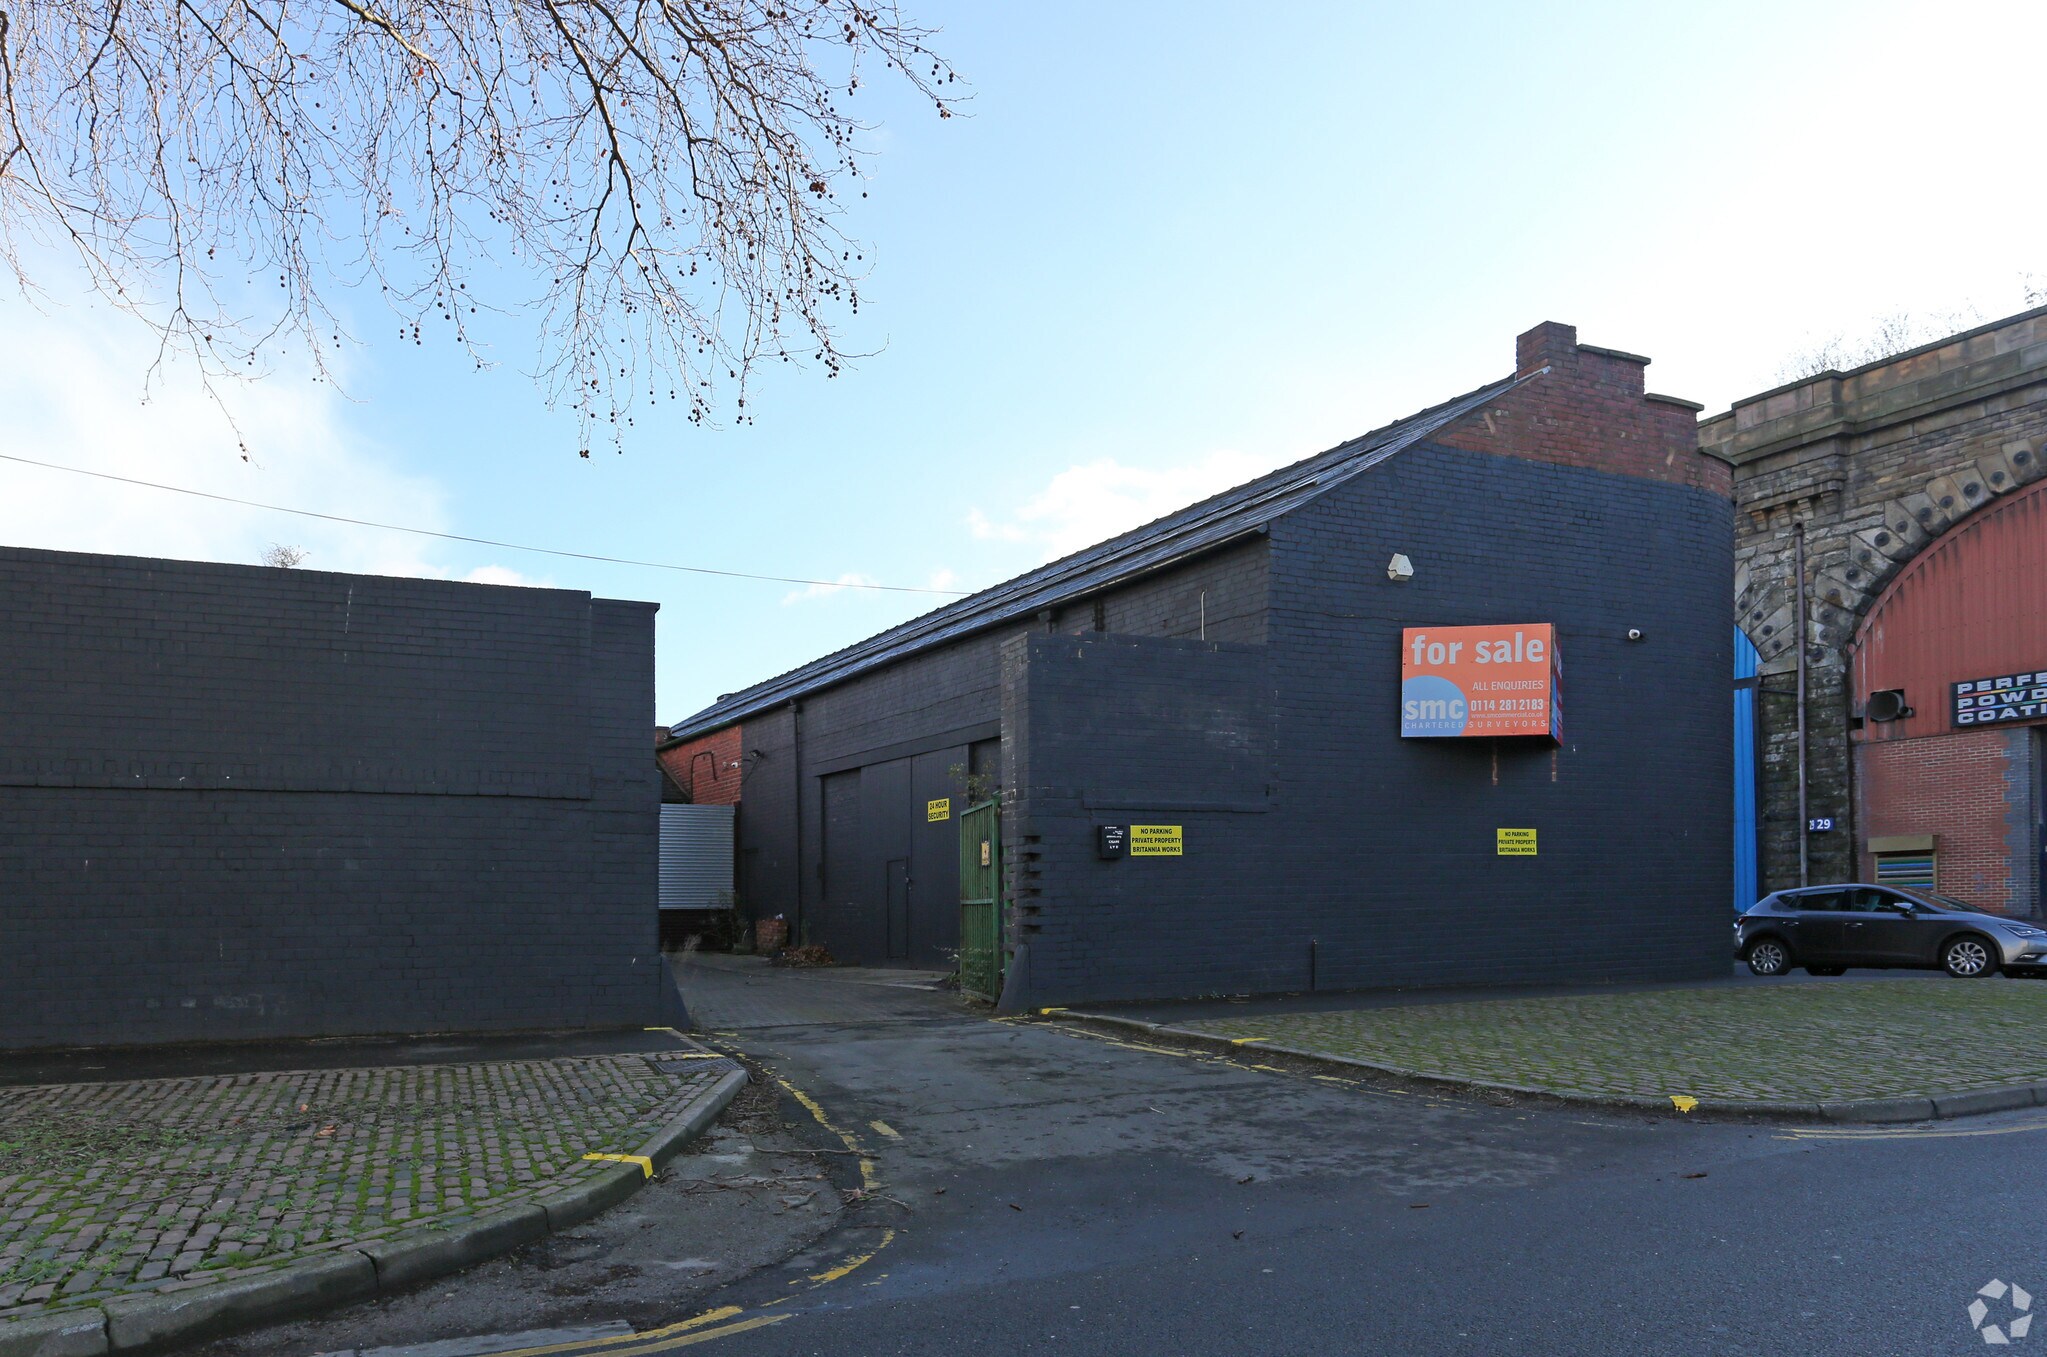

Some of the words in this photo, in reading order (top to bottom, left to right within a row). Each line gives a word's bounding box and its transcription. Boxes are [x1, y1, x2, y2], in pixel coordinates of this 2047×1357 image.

[1411, 635, 1463, 665] for
[1475, 632, 1544, 664] sale
[1472, 681, 1489, 691] ALL
[1491, 680, 1544, 691] ENQUIRIES
[1404, 698, 1464, 720] smc
[1471, 700, 1495, 711] 0114
[1499, 699, 1517, 711] 281
[1519, 698, 1544, 710] 2183
[1404, 720, 1464, 729] CHARTERED
[1468, 719, 1547, 728] SURVEYORS
[928, 811, 948, 820] SECURITY
[1816, 819, 1831, 830] 29
